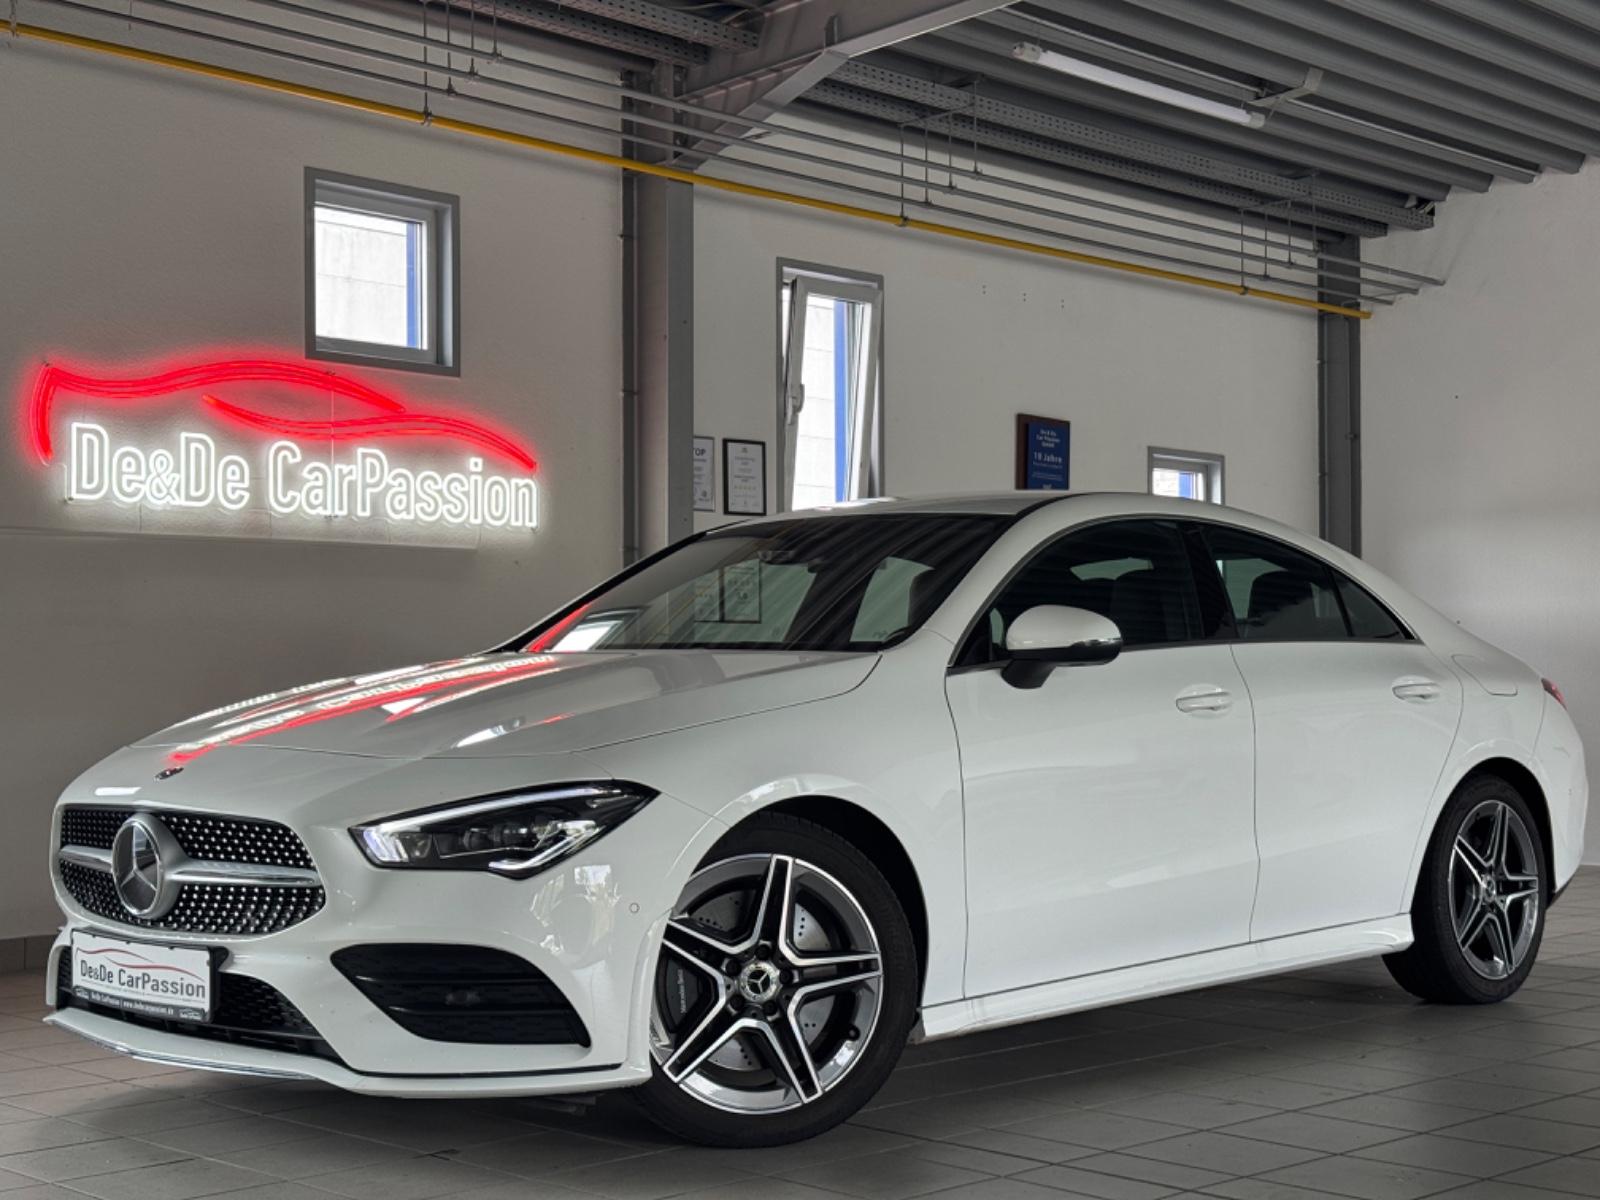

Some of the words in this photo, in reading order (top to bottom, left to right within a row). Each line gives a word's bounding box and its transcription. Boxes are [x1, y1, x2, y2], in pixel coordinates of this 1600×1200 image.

[693, 447, 706, 456] OP
[71, 422, 250, 509] De&De
[268, 440, 538, 528] CarPassion
[80, 960, 114, 984] De&De
[118, 969, 206, 998] CarPassion
